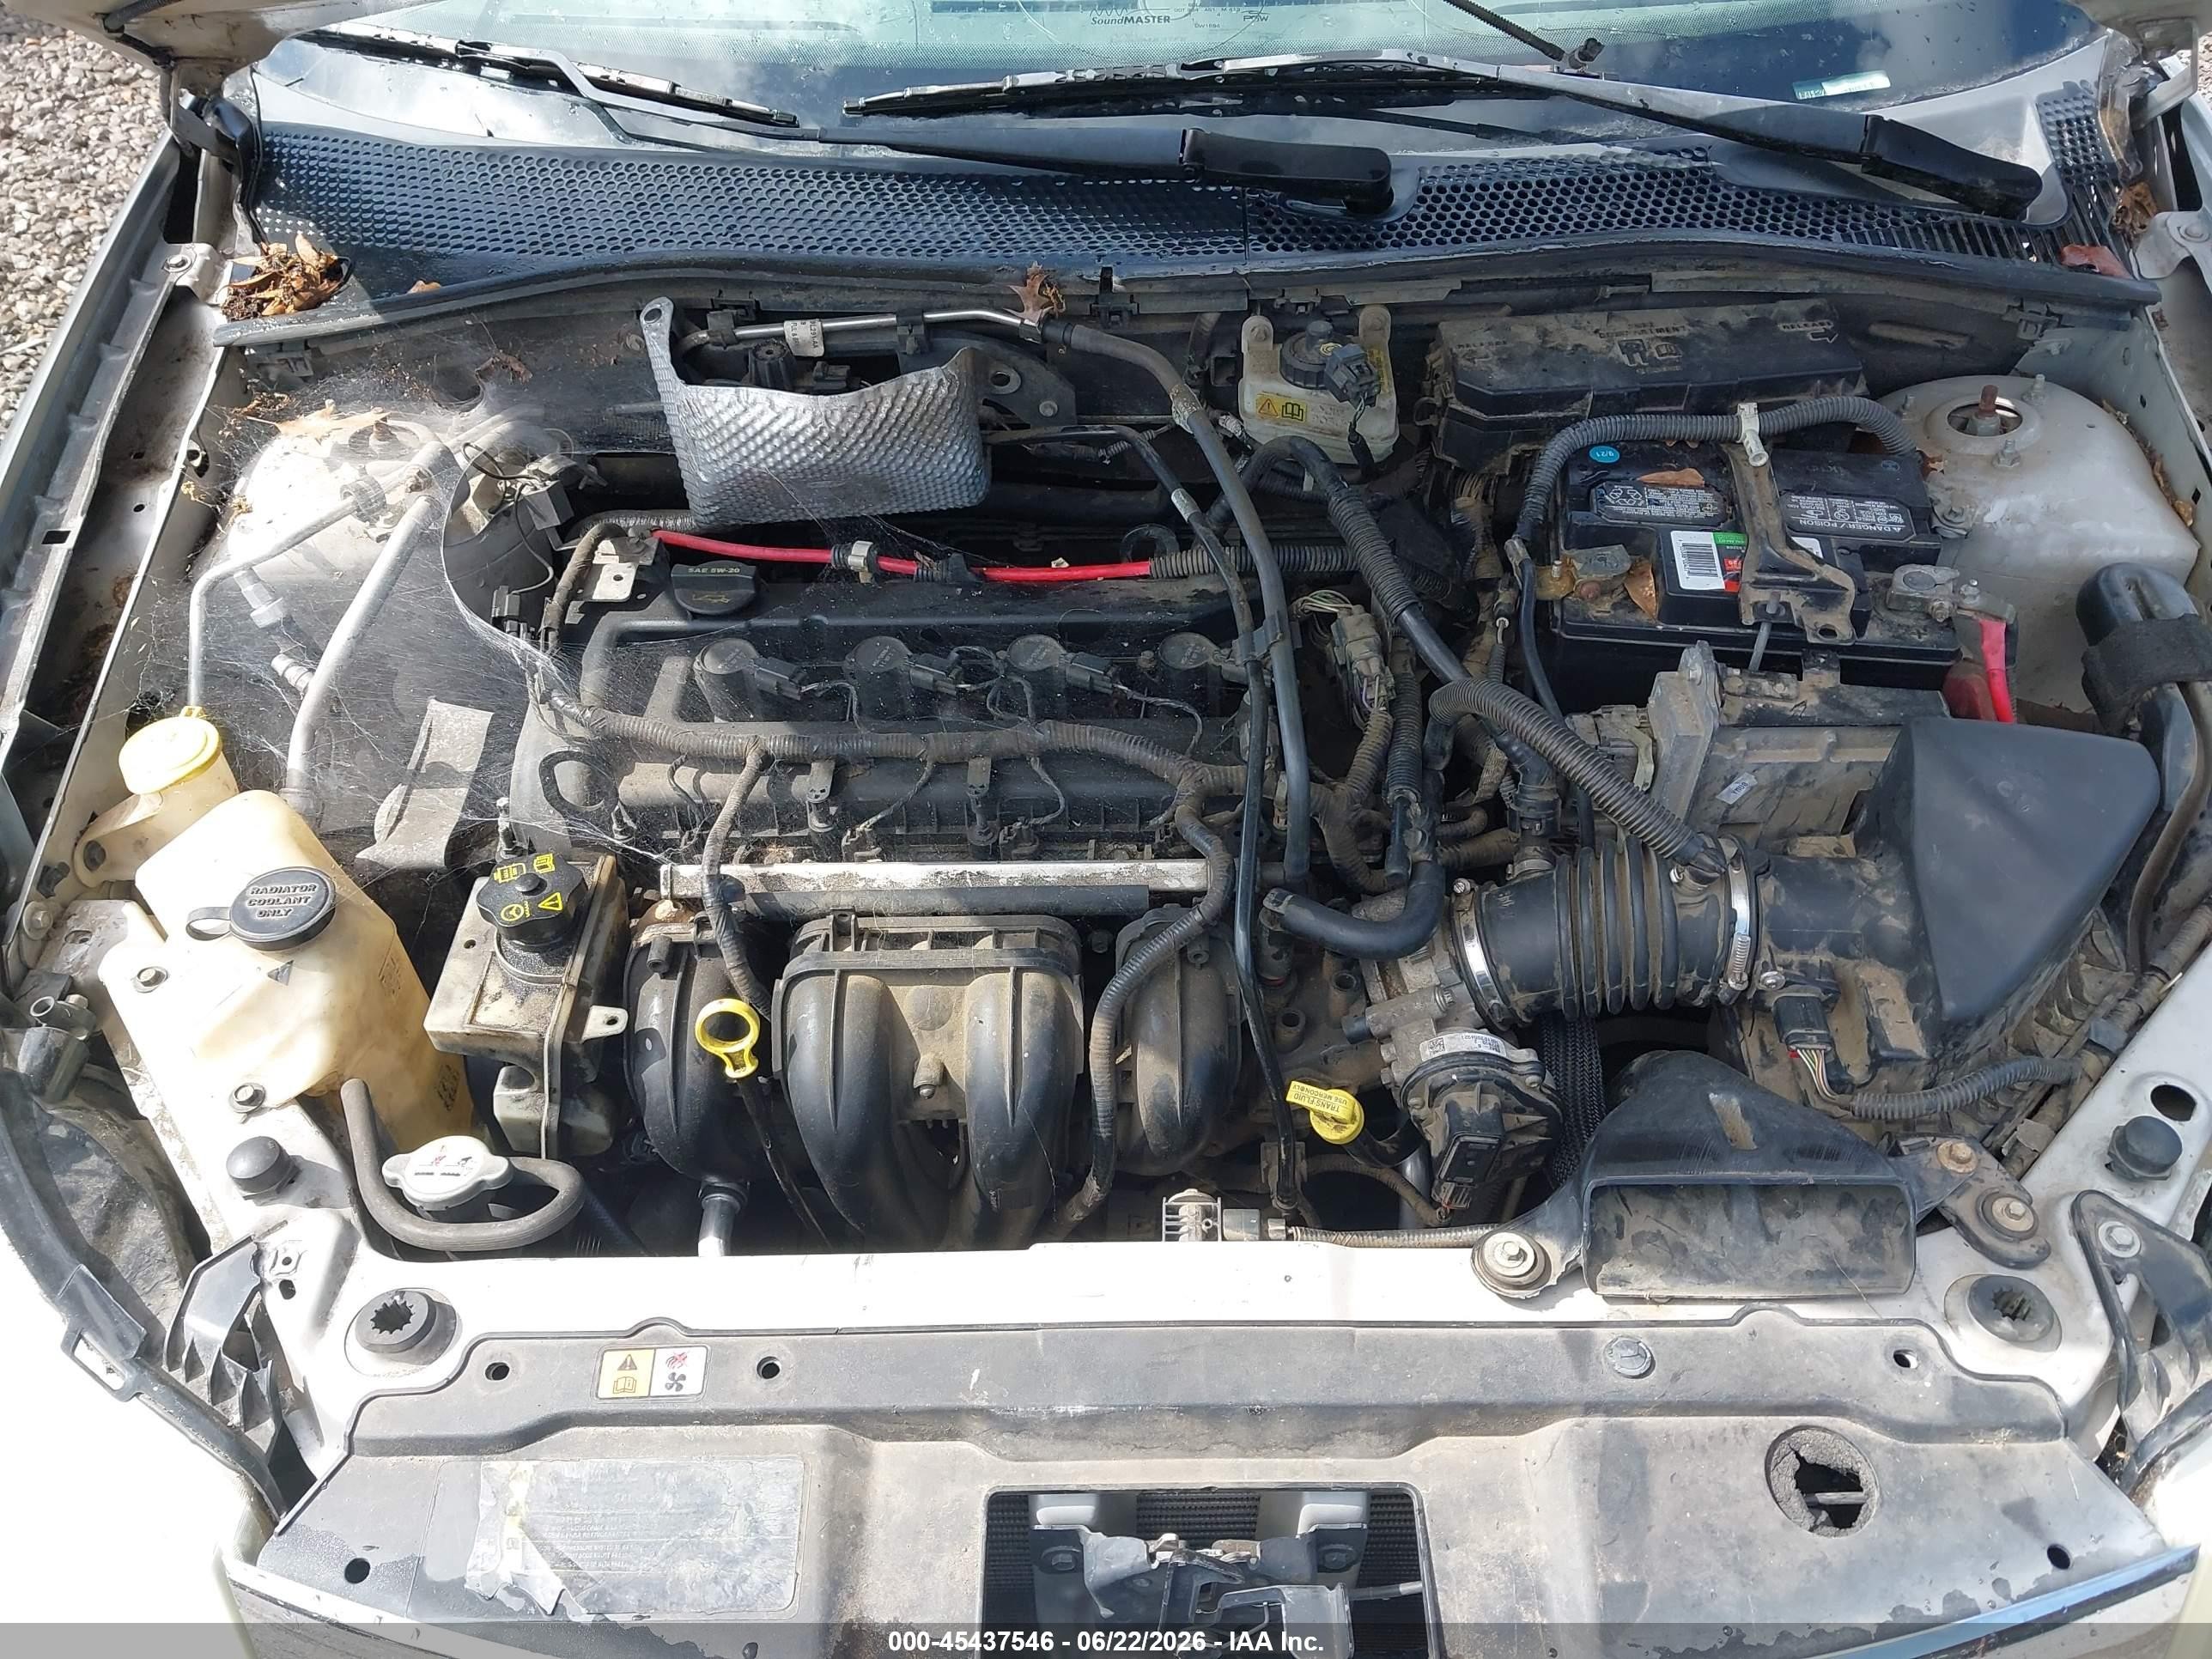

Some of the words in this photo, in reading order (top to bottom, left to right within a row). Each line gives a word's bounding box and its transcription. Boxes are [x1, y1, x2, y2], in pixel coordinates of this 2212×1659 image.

[1091, 15, 1171, 25] SoundMASTER
[1799, 520, 1837, 528] POISON
[1847, 522, 1890, 532] DANGER
[250, 884, 318, 895] RADIATOR
[247, 896, 312, 907] COOLANT
[256, 908, 293, 918] ONLY
[1293, 1092, 1315, 1104] FLUID
[1315, 1098, 1340, 1113] TRANS
